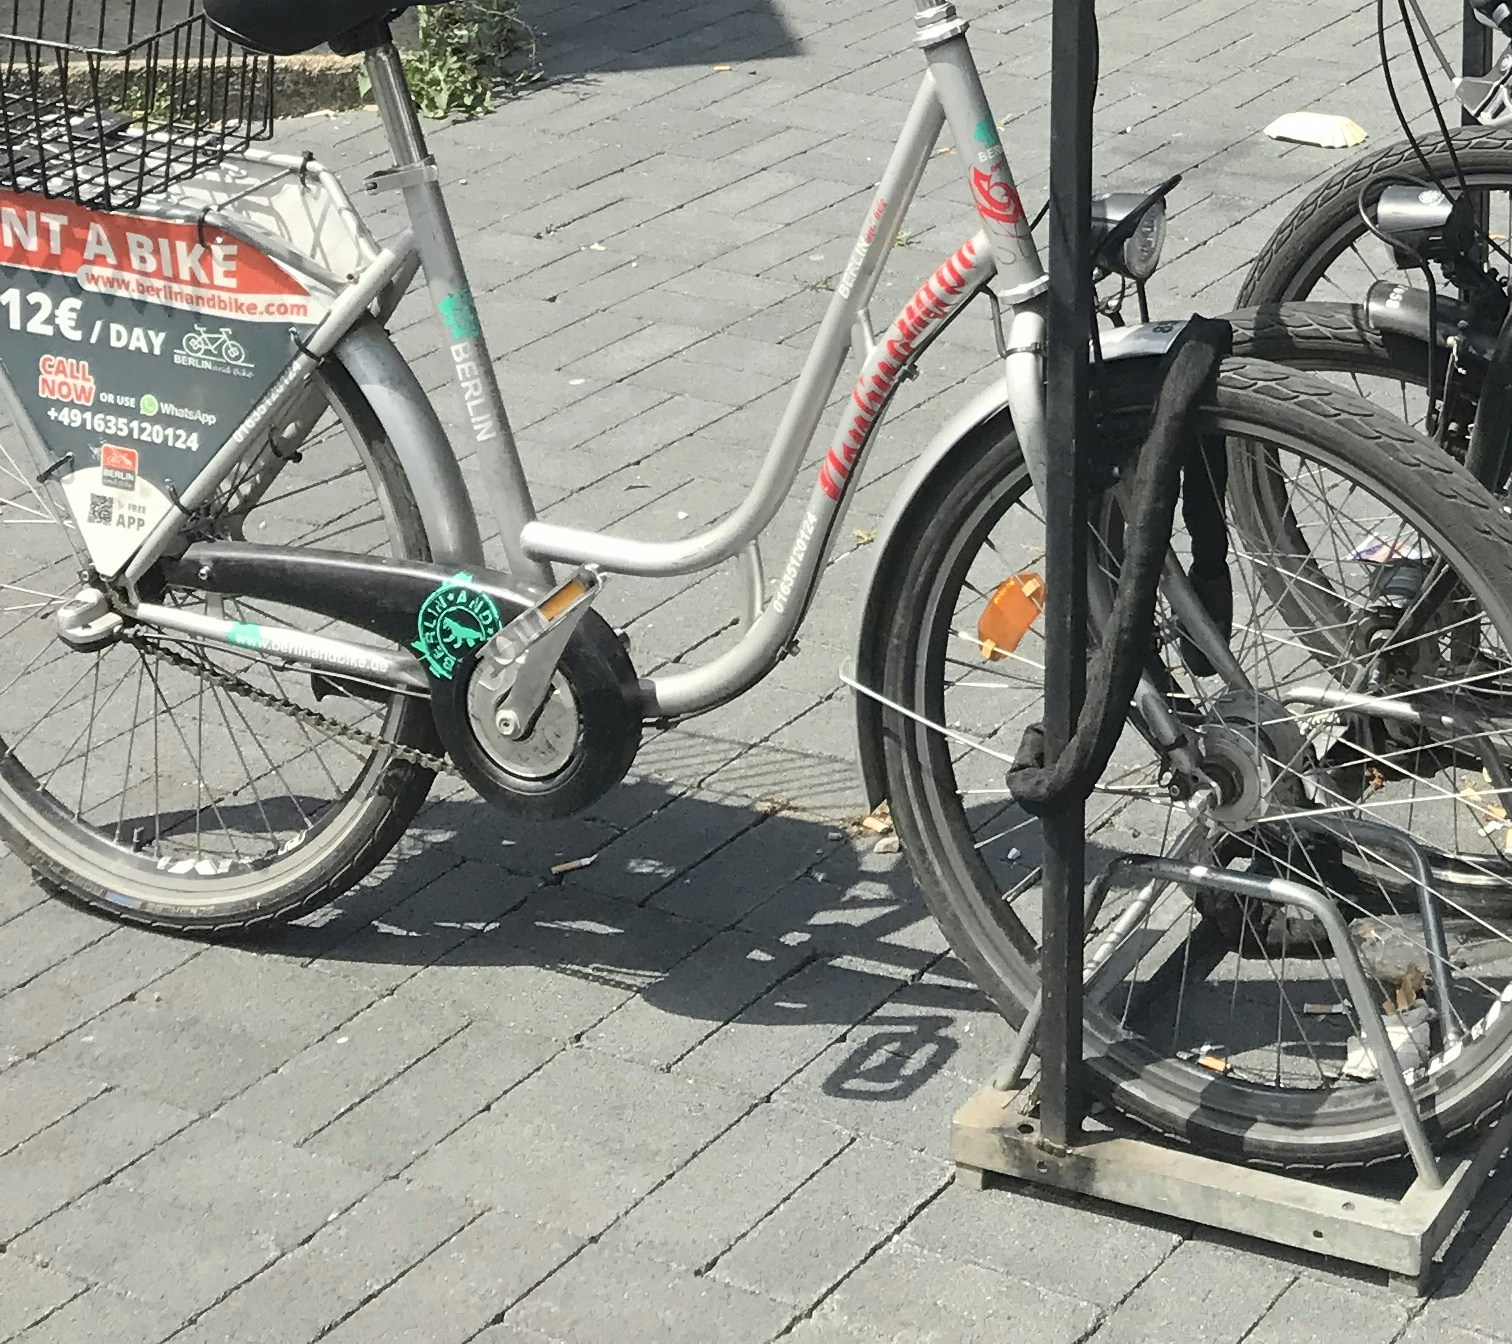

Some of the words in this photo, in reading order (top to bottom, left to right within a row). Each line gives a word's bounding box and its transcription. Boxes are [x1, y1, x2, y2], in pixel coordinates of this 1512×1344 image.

[83, 223, 117, 265] A
[126, 231, 238, 289] BIKE
[837, 239, 871, 301] BERLIN
[85, 271, 308, 317] www.berlinandbike.com
[0, 287, 83, 342] 12€
[89, 319, 104, 344] /
[109, 323, 166, 355] DAY
[39, 354, 94, 383] CALL
[173, 354, 212, 371] BERLIN
[39, 375, 95, 406] NOW
[100, 392, 115, 404] OR
[116, 394, 136, 409] USE
[160, 401, 217, 426] WhatsApp
[450, 342, 498, 443] BERLIN
[47, 406, 200, 452] +491635120124
[102, 468, 135, 482] BERLIN
[115, 513, 146, 531] APP
[126, 502, 147, 514] FREE
[772, 510, 818, 614] 01635120124
[422, 595, 456, 672] BERLIN
[456, 589, 495, 625] AND
